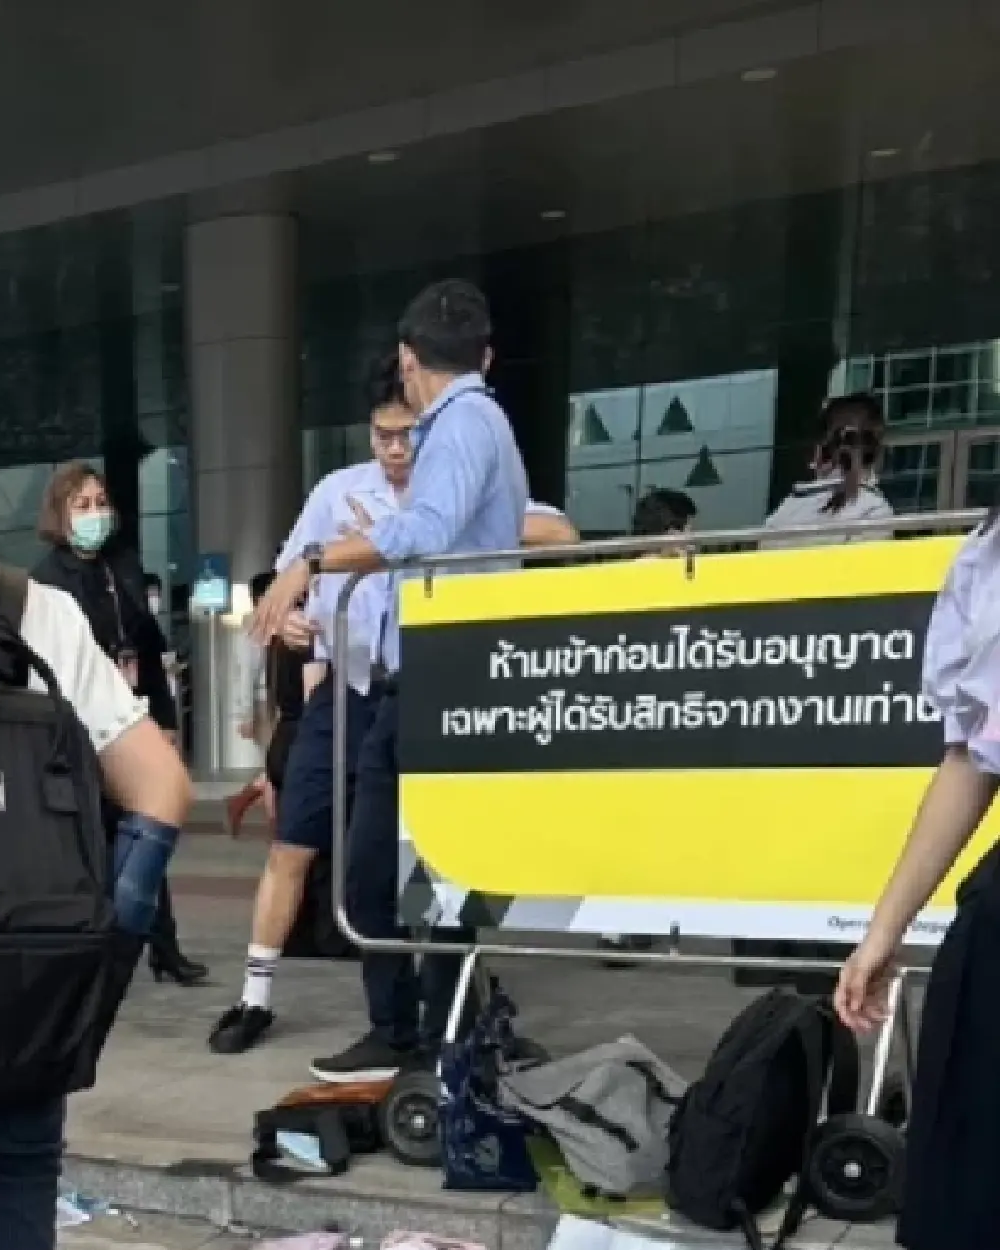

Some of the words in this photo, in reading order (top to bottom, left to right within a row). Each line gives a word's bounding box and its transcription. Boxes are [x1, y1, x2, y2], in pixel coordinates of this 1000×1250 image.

[489, 624, 915, 680] ห้ามเข้าก่อนได้รับอนุญาต
